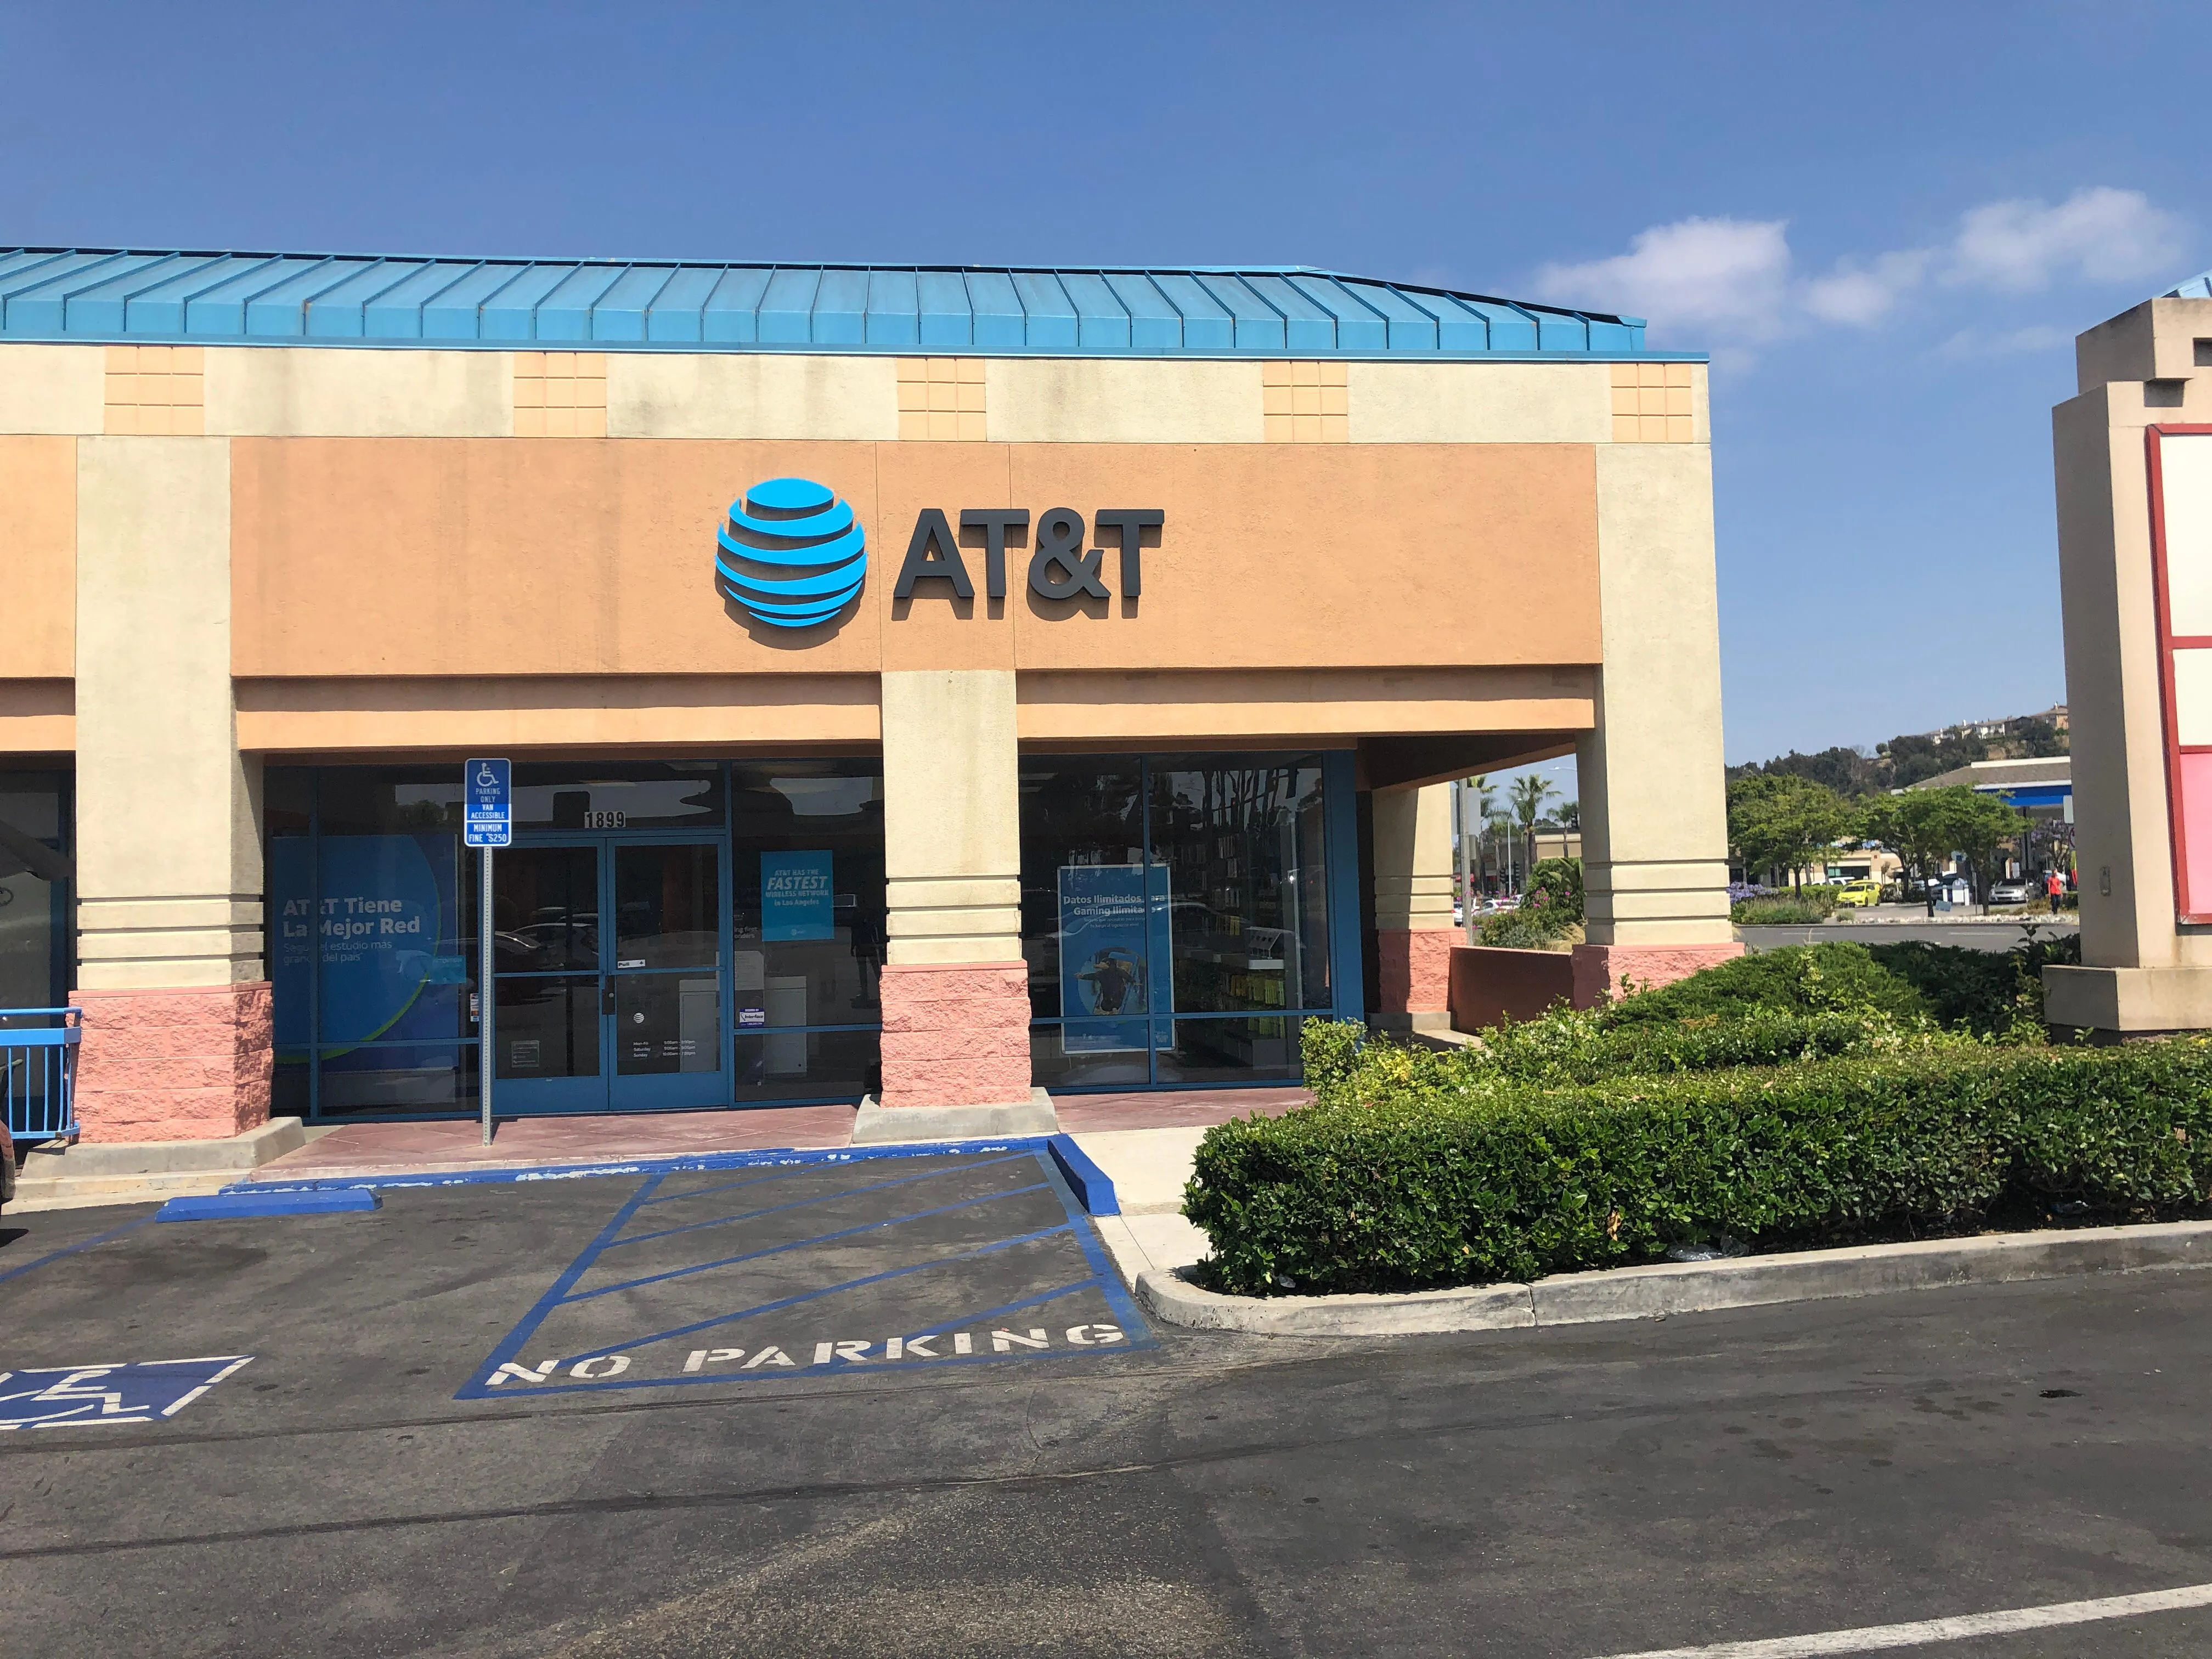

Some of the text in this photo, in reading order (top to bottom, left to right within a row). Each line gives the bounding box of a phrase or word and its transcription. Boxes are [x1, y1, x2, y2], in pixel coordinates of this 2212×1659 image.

[893, 507, 1164, 599] AT&T
[586, 811, 624, 827] 1899
[473, 823, 503, 832] MINIMUM
[469, 834, 483, 842] FINE
[766, 876, 829, 890] FASTEST
[798, 889, 829, 897] NETWORK
[344, 896, 402, 914] Tiene
[795, 898, 820, 906] Angeles
[1063, 896, 1092, 905] Datos
[1094, 894, 1142, 903] Ilimitados
[1074, 906, 1111, 917] Gaming
[283, 921, 307, 938] La
[380, 916, 420, 934] Red
[330, 940, 369, 951] estudio
[322, 952, 337, 962] del
[484, 1323, 1125, 1386] NO PARKING
